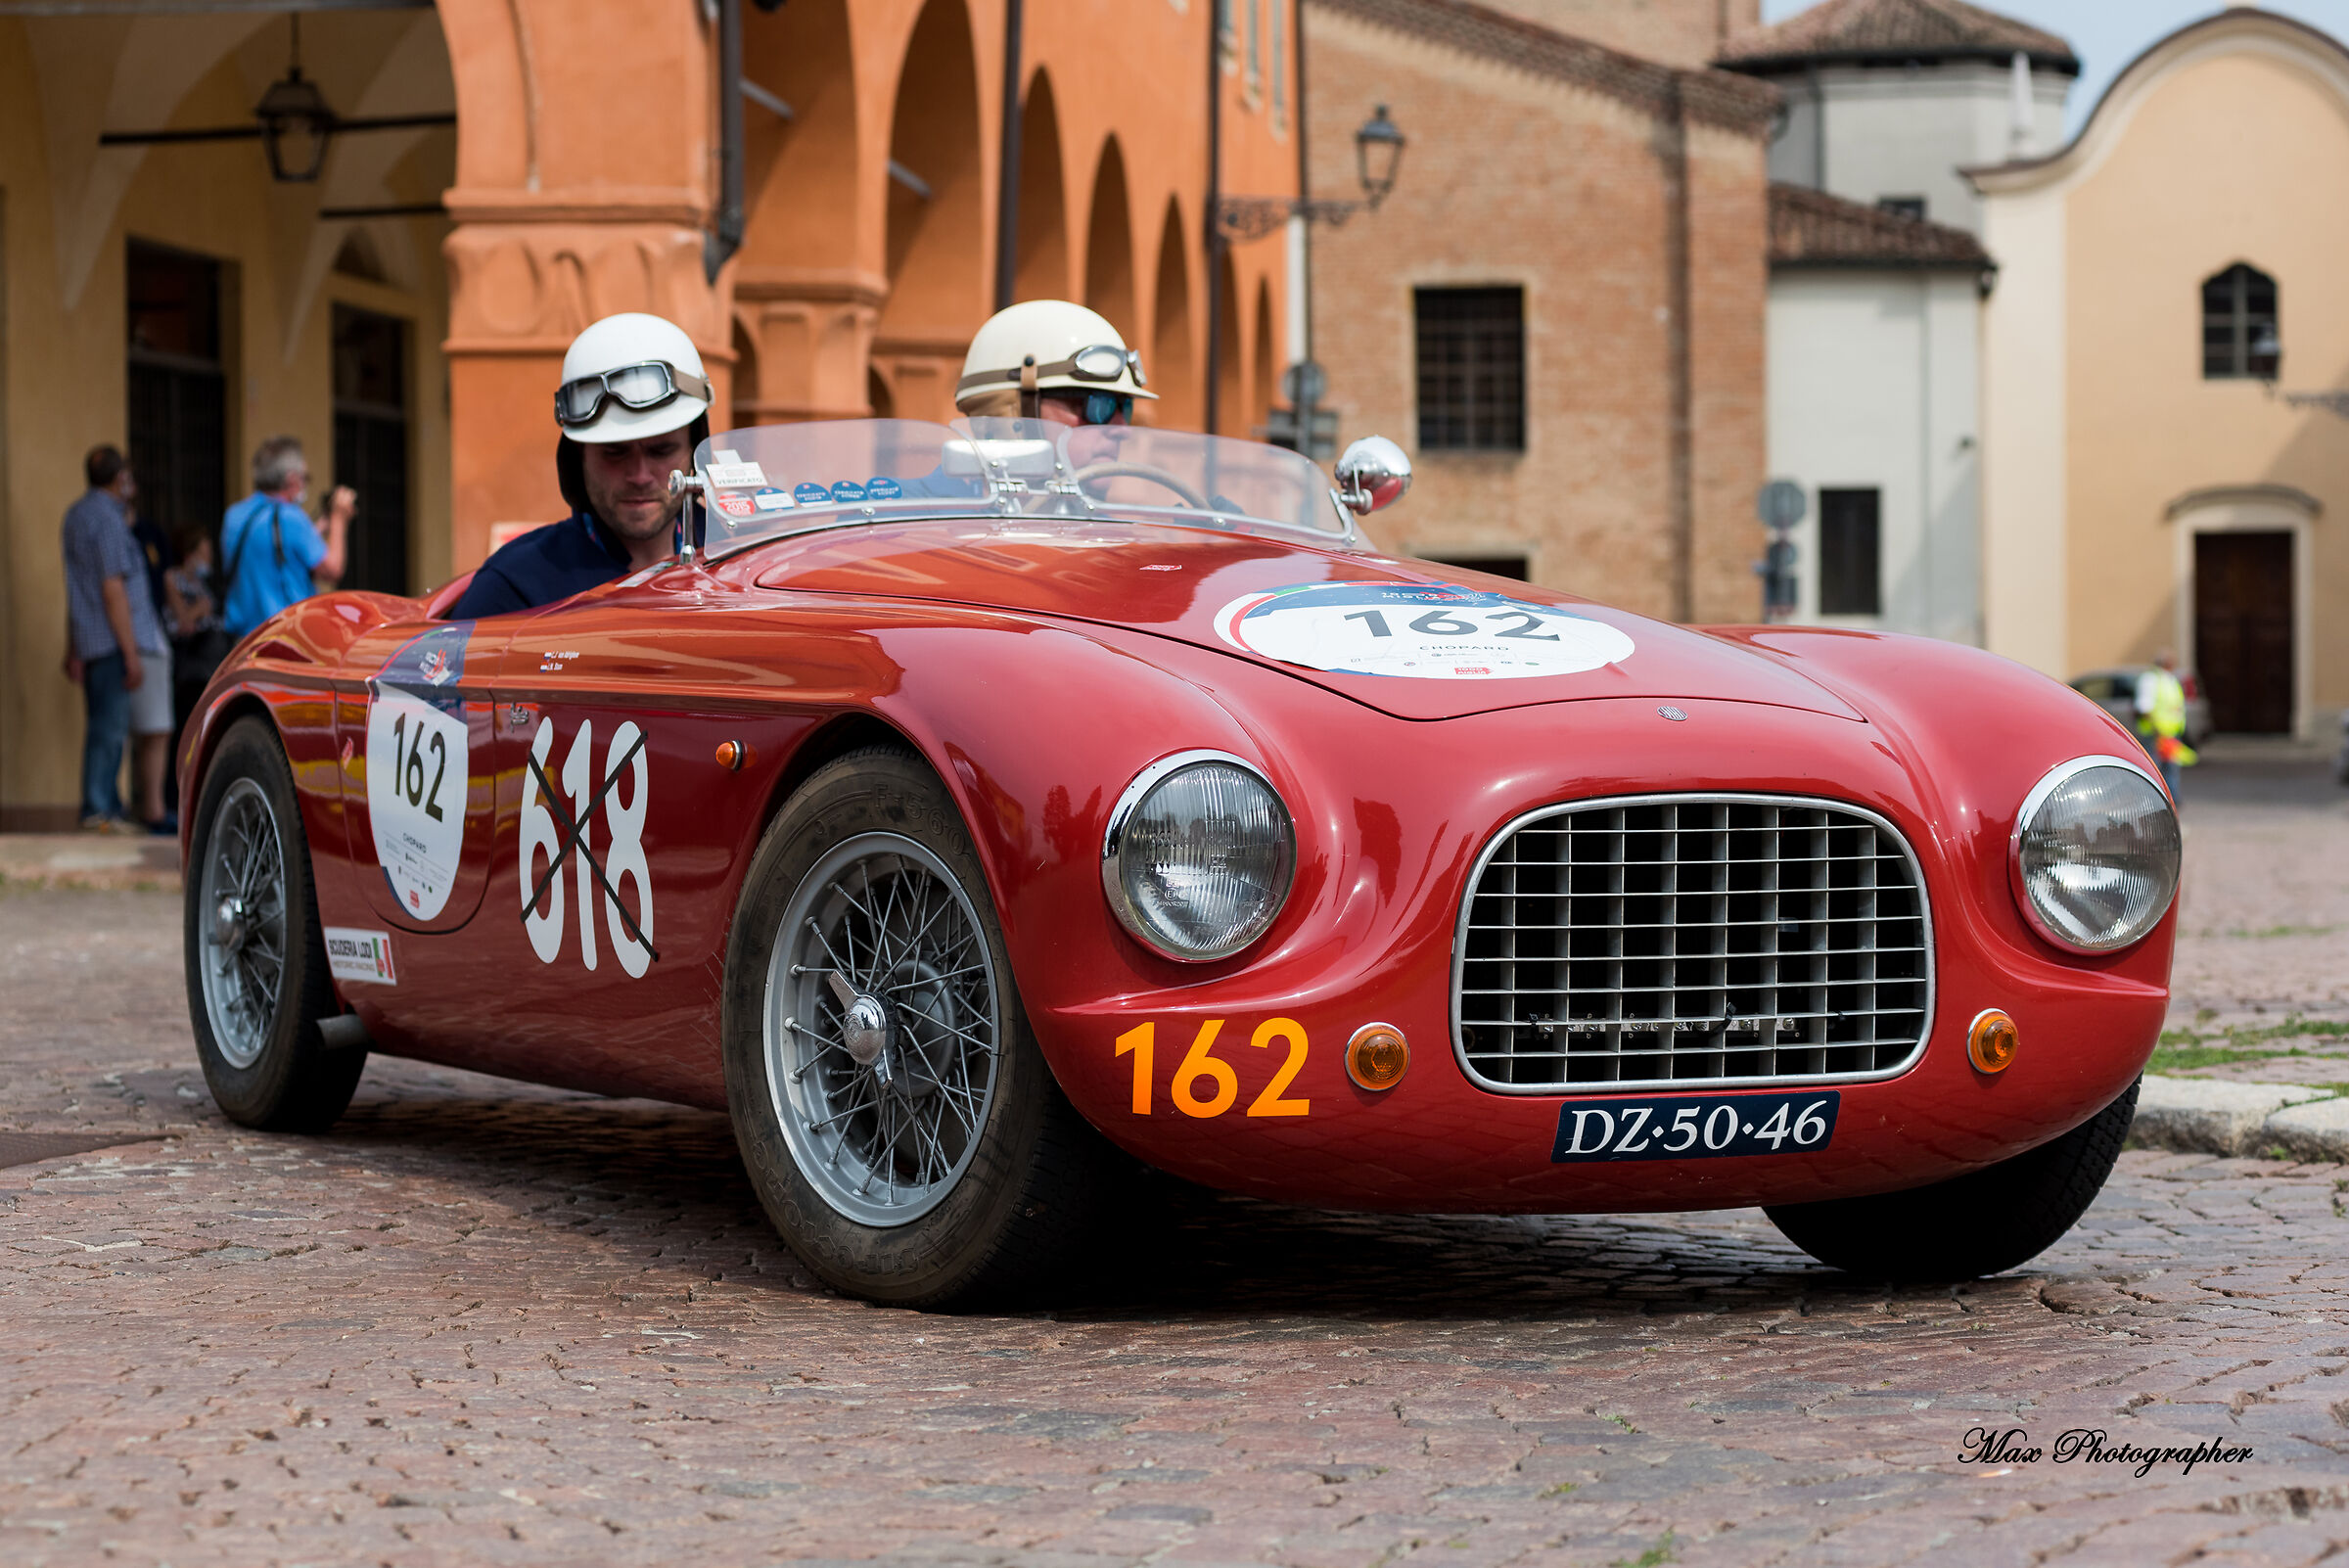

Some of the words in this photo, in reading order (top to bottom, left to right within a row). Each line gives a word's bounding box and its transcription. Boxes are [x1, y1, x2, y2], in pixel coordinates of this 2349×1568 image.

[1344, 610, 1560, 641] 162
[393, 713, 446, 822] 162
[519, 716, 653, 979] 618
[1115, 1017, 1311, 1119] 162
